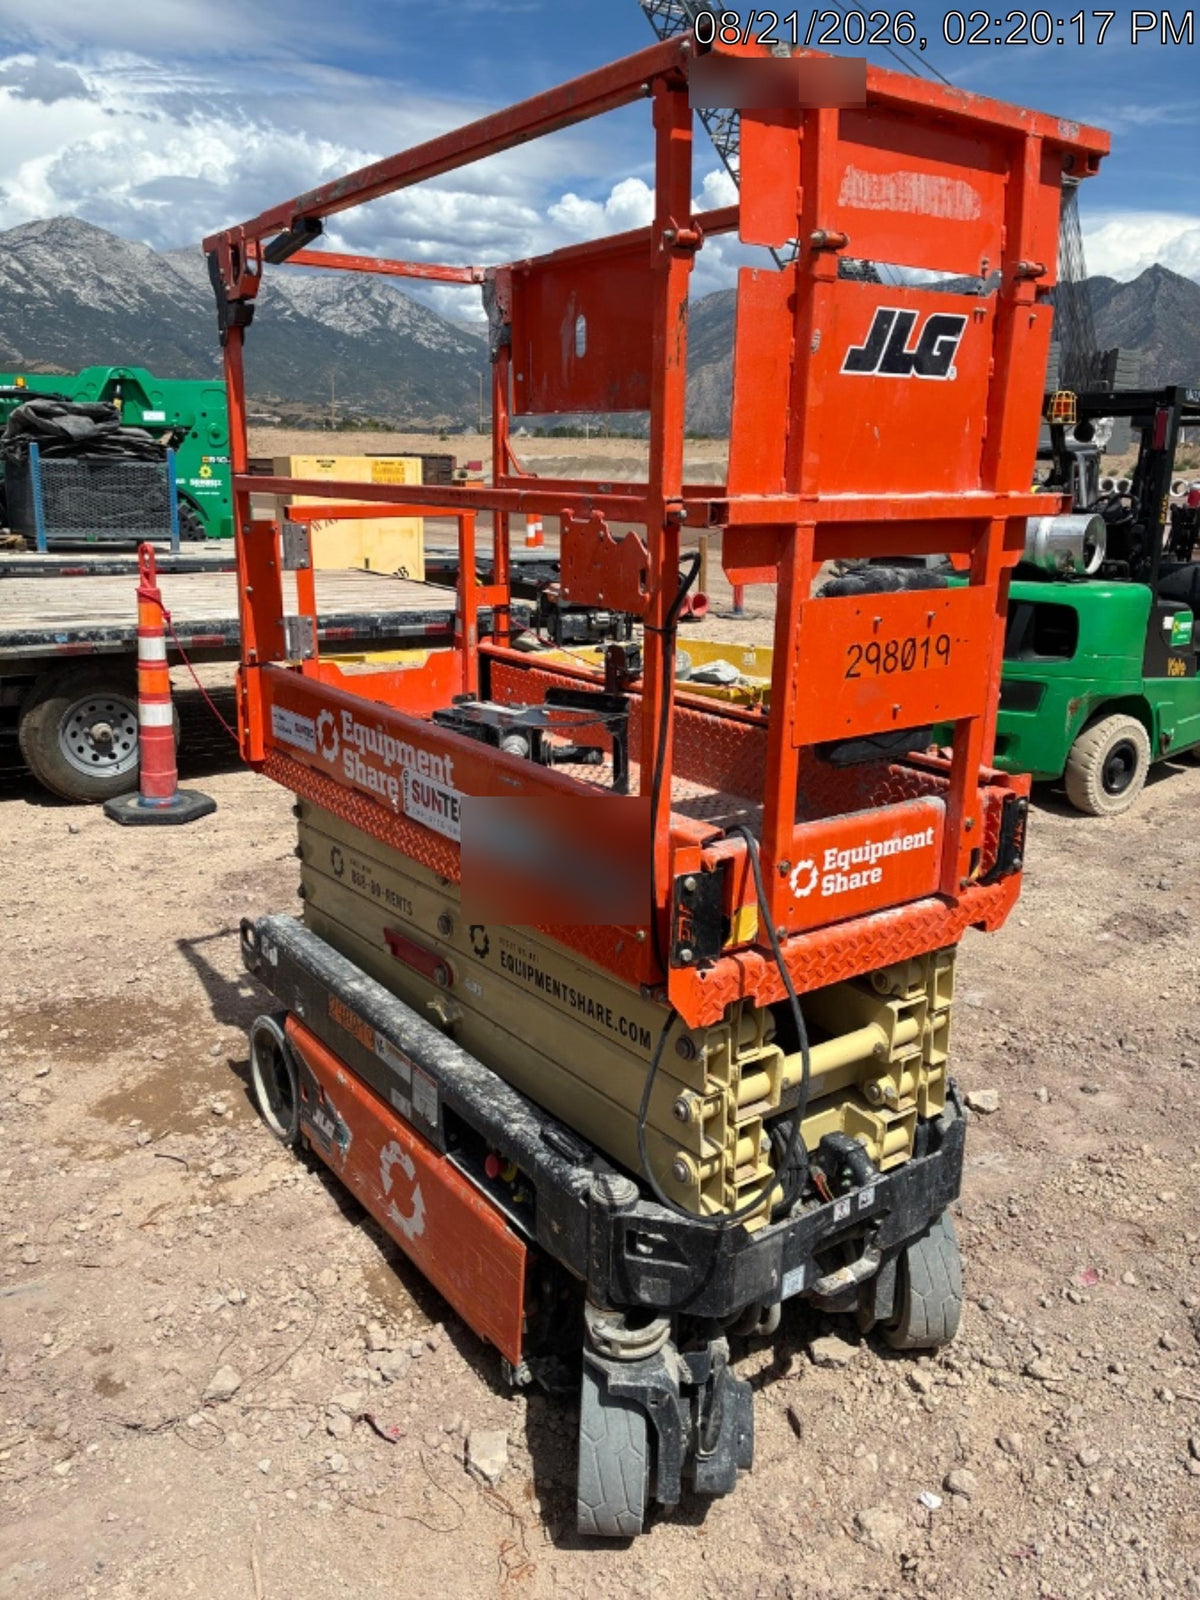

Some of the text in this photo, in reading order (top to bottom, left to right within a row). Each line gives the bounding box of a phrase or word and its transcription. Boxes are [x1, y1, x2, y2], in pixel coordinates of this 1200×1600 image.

[839, 306, 969, 380] JLG
[845, 634, 951, 678] 298019
[340, 709, 455, 788] Equipment
[342, 747, 400, 799] Share
[411, 779, 461, 823] SUNTE
[823, 826, 935, 873] Equipment
[821, 867, 883, 896] Share
[500, 949, 652, 1051] EQUIPMENTSHARE.COM
